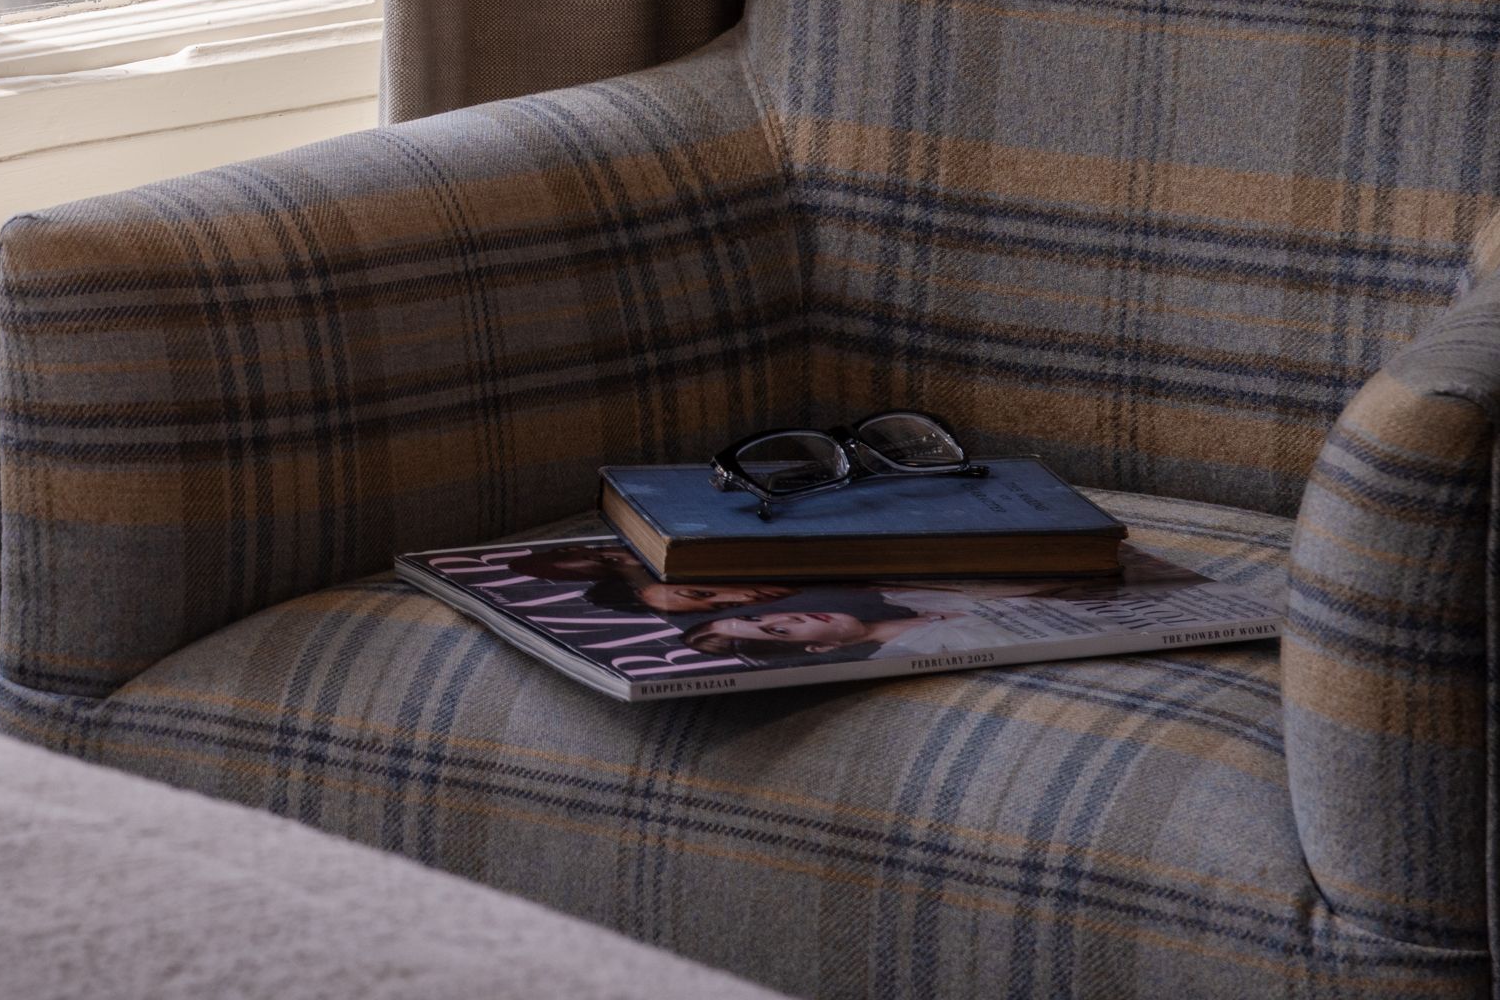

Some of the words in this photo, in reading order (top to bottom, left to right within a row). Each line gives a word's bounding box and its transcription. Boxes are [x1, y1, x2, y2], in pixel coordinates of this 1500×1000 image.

[1162, 635, 1183, 645] THE
[1185, 631, 1221, 643] POWER
[1222, 628, 1237, 638] OF
[1239, 624, 1277, 637] WOMEN
[911, 656, 965, 670] FEBRUARY
[967, 653, 995, 665] 2023
[641, 683, 692, 696] HARPER'S
[695, 678, 737, 691] BAZAAR
